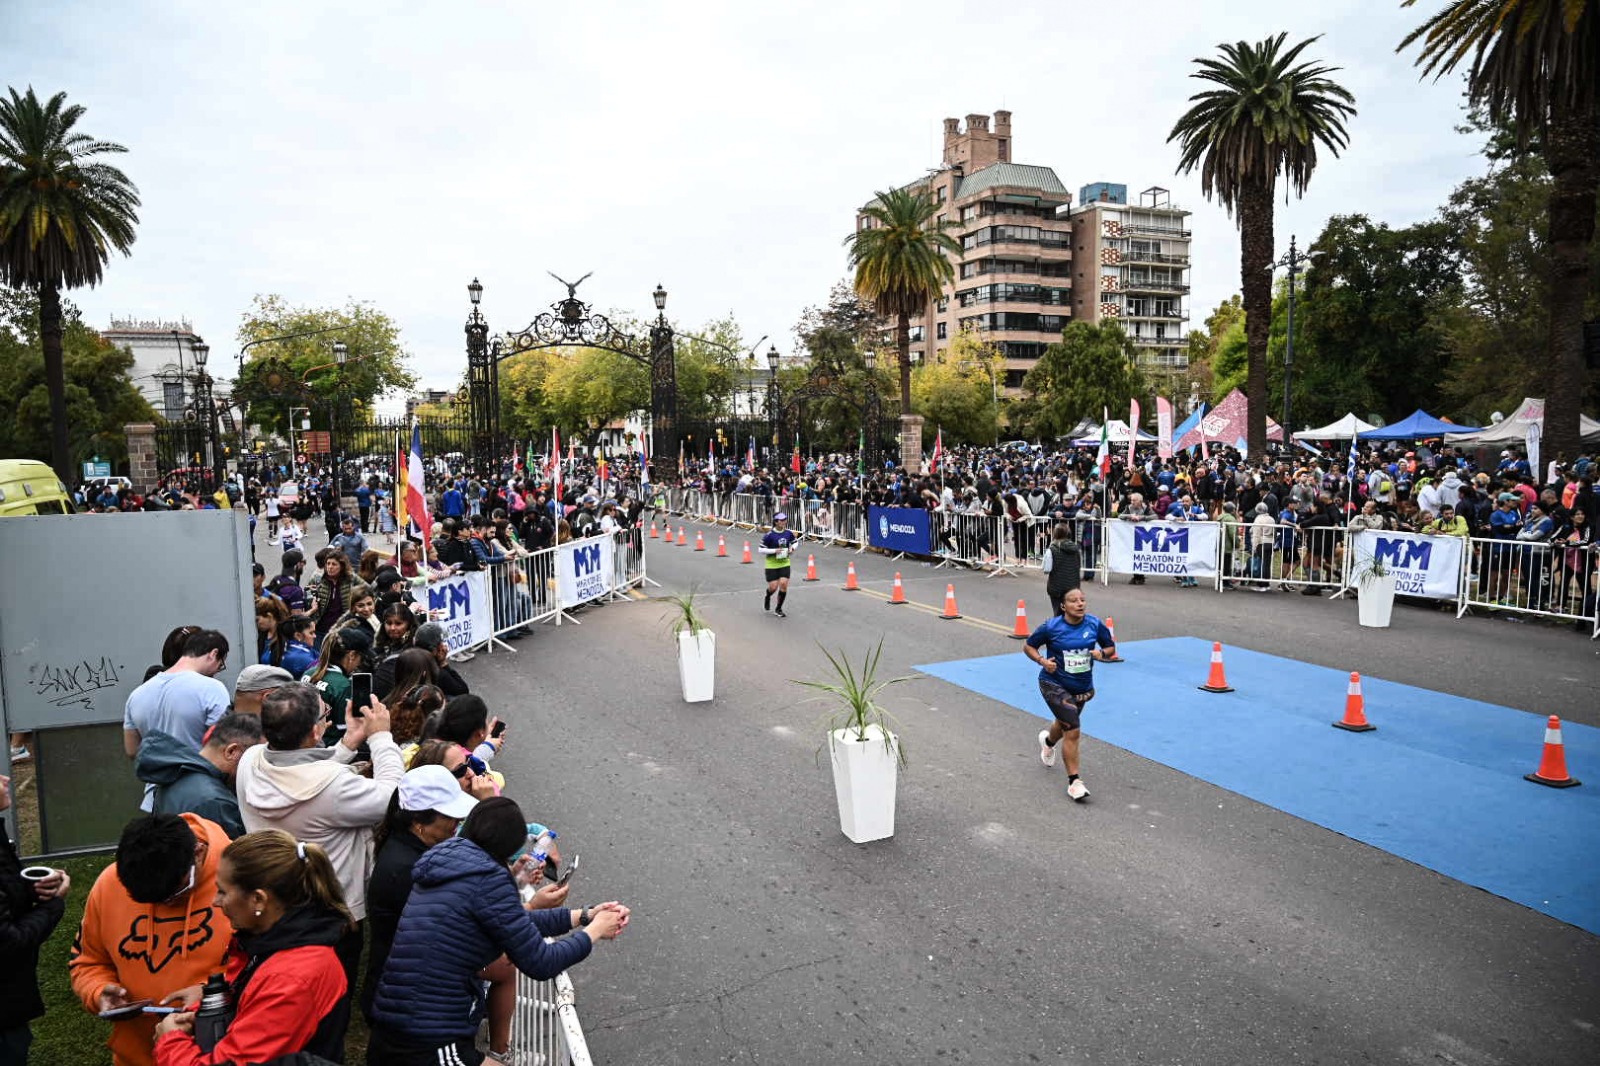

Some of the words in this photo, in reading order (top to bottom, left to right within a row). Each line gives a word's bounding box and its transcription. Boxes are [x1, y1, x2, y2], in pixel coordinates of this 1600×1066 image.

[890, 523, 915, 534] MENDOZA
[1134, 526, 1188, 553] MM
[574, 543, 600, 577] MM
[1133, 553, 1174, 563] MARATÓN
[1375, 537, 1432, 570] MM
[1133, 562, 1188, 574] MENDOZA
[1414, 573, 1426, 582] DE
[577, 583, 604, 600] MENDOZA
[1395, 580, 1425, 594] DOZA
[463, 619, 473, 631] DE
